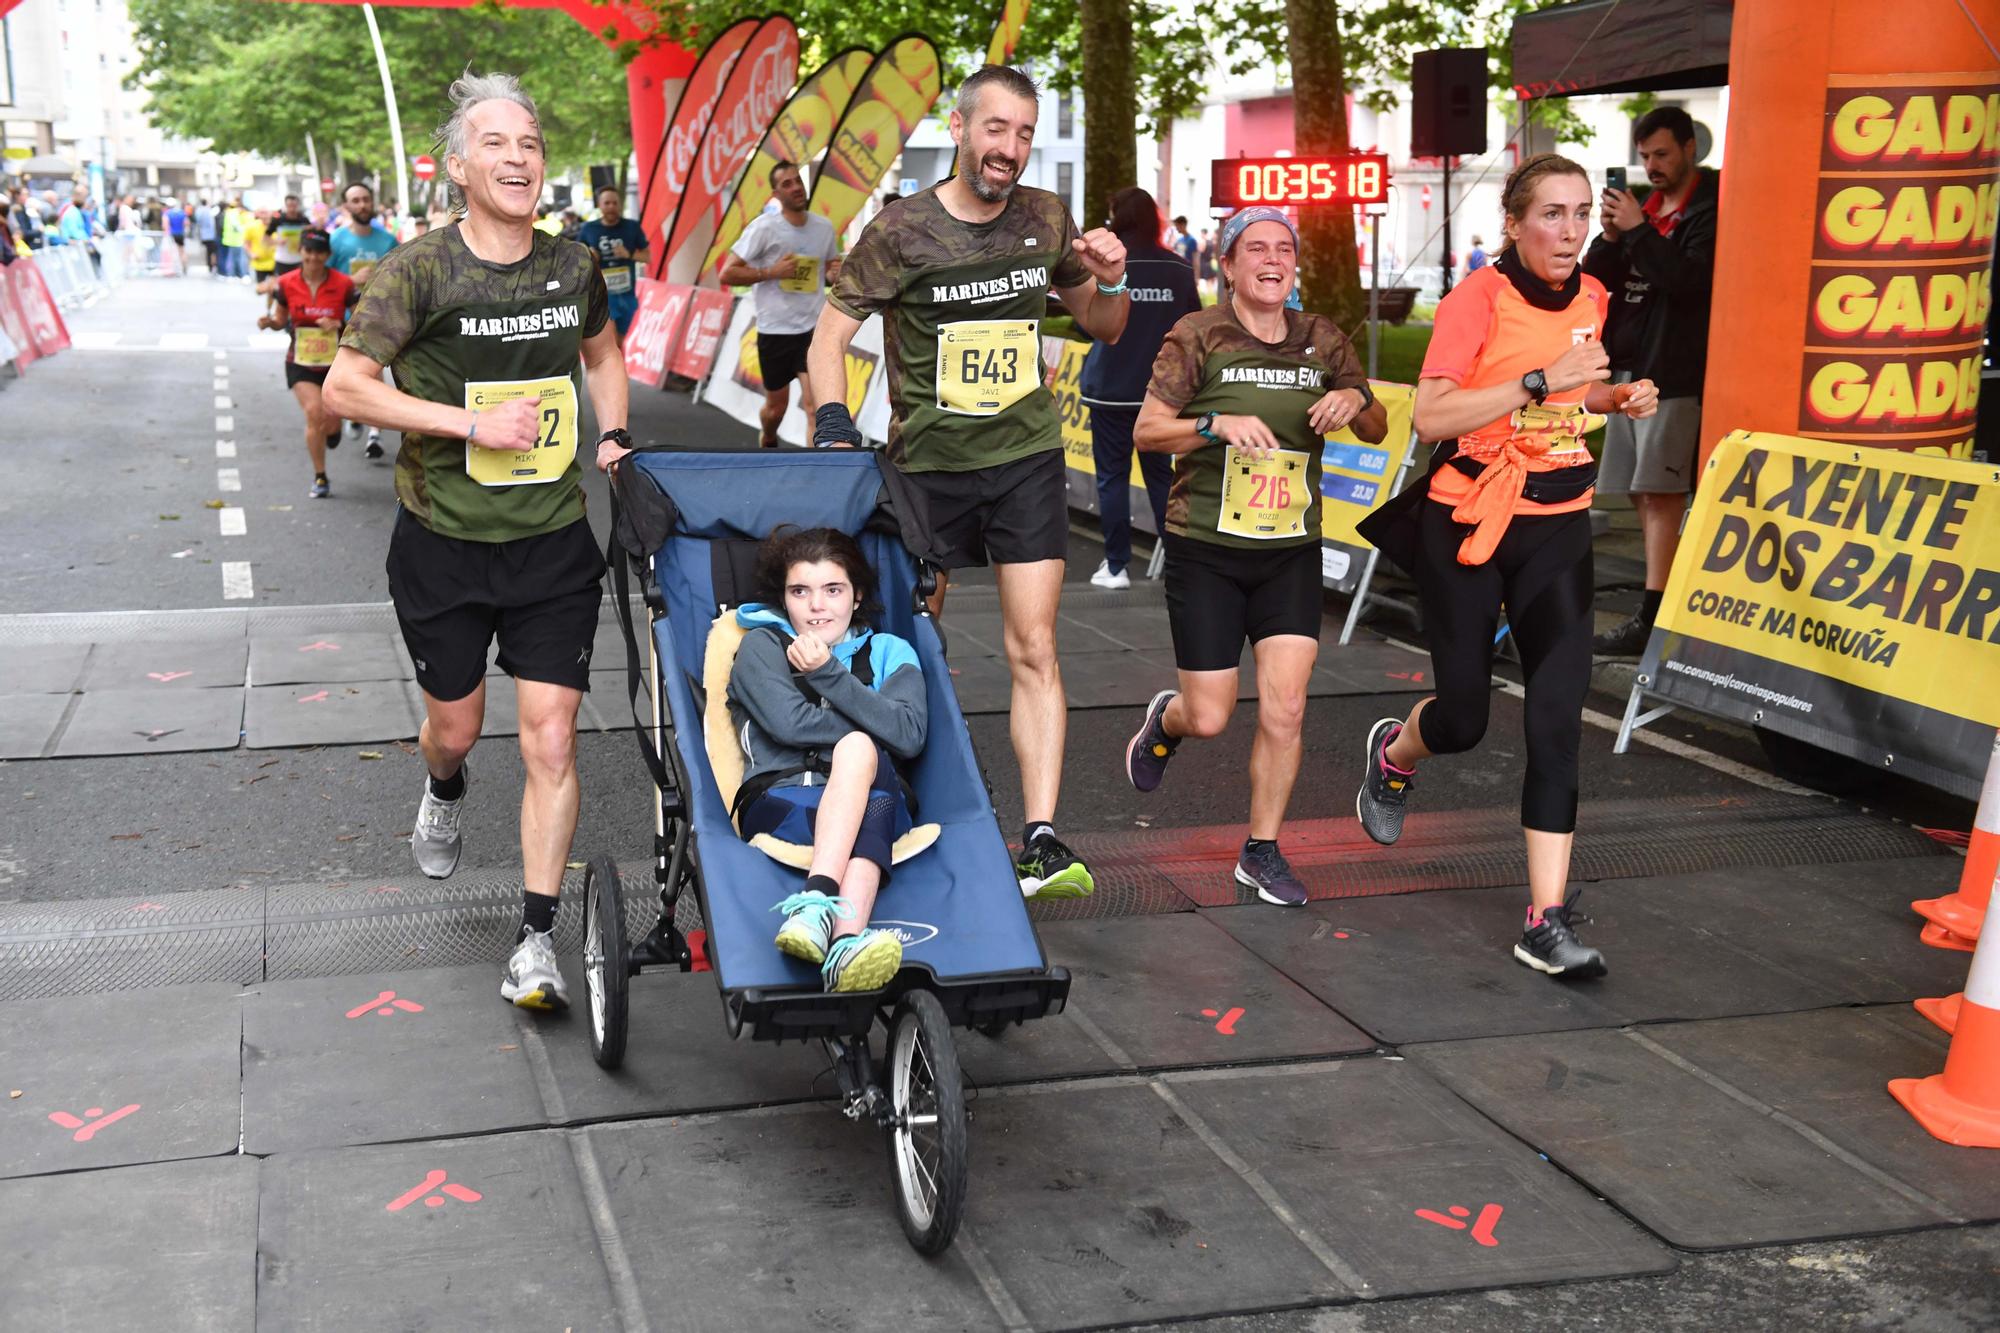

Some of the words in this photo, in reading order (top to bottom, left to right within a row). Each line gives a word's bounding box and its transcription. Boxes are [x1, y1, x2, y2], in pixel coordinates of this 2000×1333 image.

[930, 277, 1009, 303] MARINES
[1010, 266, 1047, 291] ENKI
[1127, 287, 1174, 301] oma
[459, 314, 541, 336] MARINES
[541, 304, 579, 330] ENKI
[961, 347, 1018, 384] 643
[1221, 367, 1296, 384] MARINES
[981, 388, 1000, 396] JAVI
[515, 454, 537, 463] MIKY
[1247, 473, 1291, 510] 216
[1719, 448, 1768, 508] A
[1763, 456, 1979, 550] XENTE
[1701, 514, 1821, 592] DOS
[1811, 541, 2000, 647] BARR
[1688, 588, 1761, 627] CORRE
[1757, 606, 1796, 639] NA
[1800, 615, 1900, 669] CORUÑA
